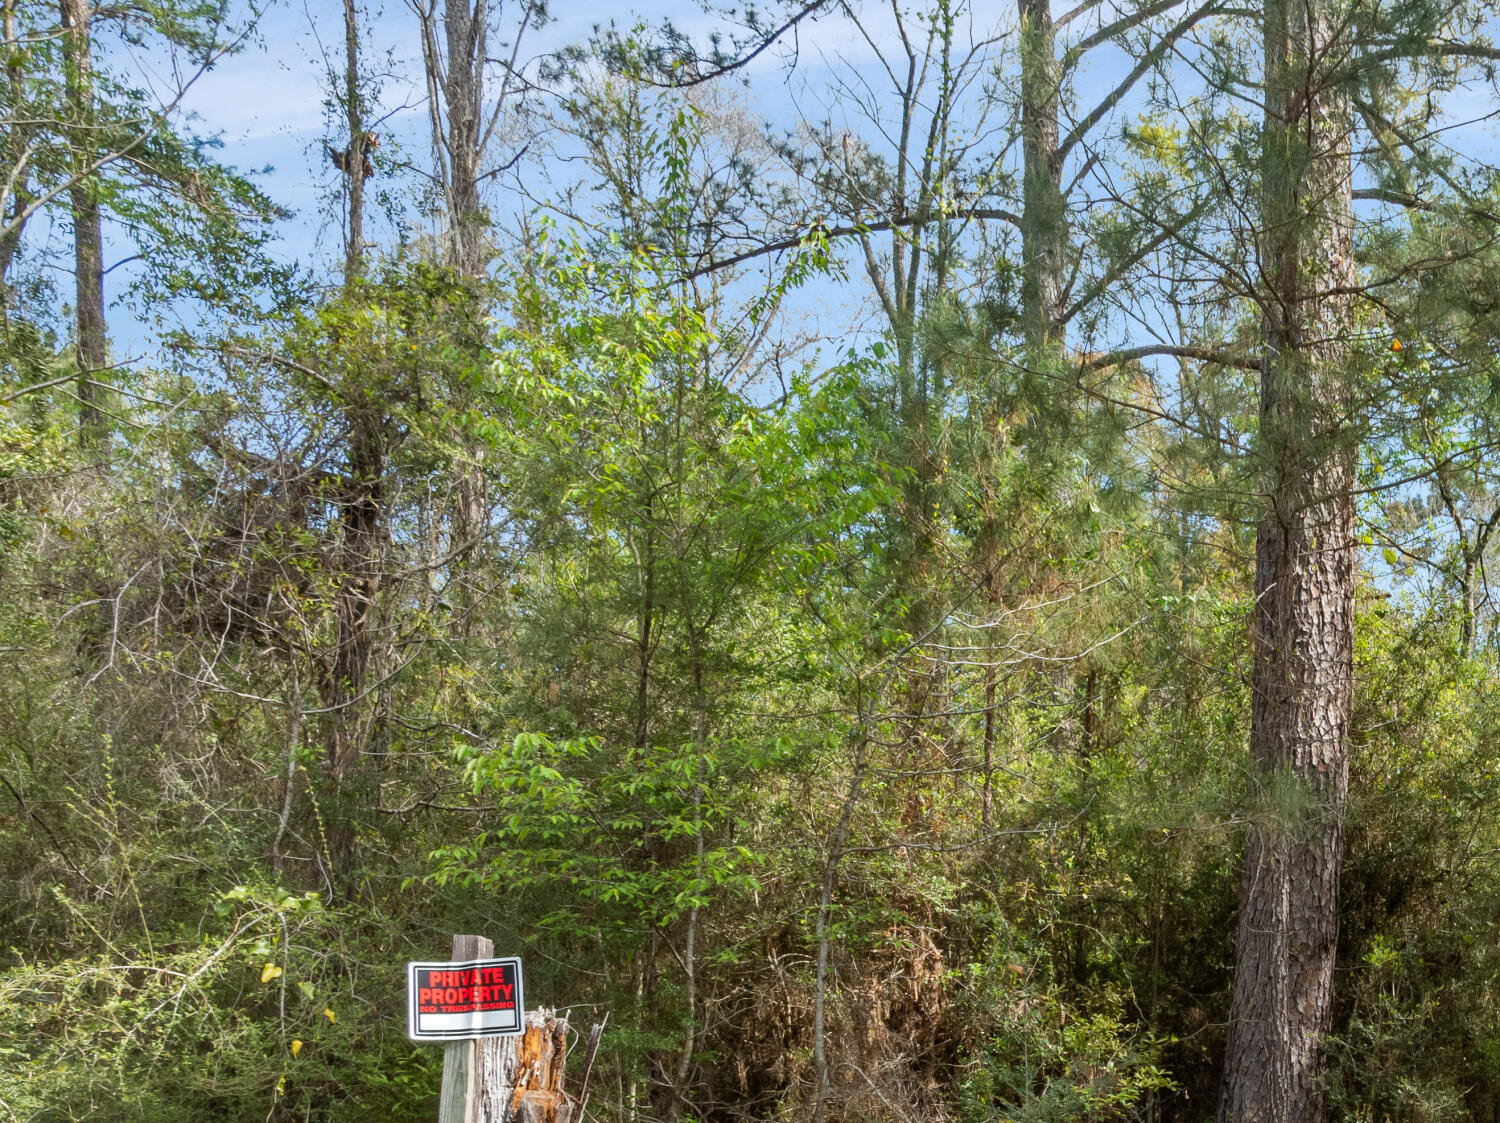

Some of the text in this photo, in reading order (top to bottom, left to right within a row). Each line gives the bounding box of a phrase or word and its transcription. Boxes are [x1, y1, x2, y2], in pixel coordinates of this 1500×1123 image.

[429, 967, 504, 987] PRIVATE
[419, 984, 513, 1004] PROPERTY
[420, 1001, 515, 1013] NO TRESPASSING
